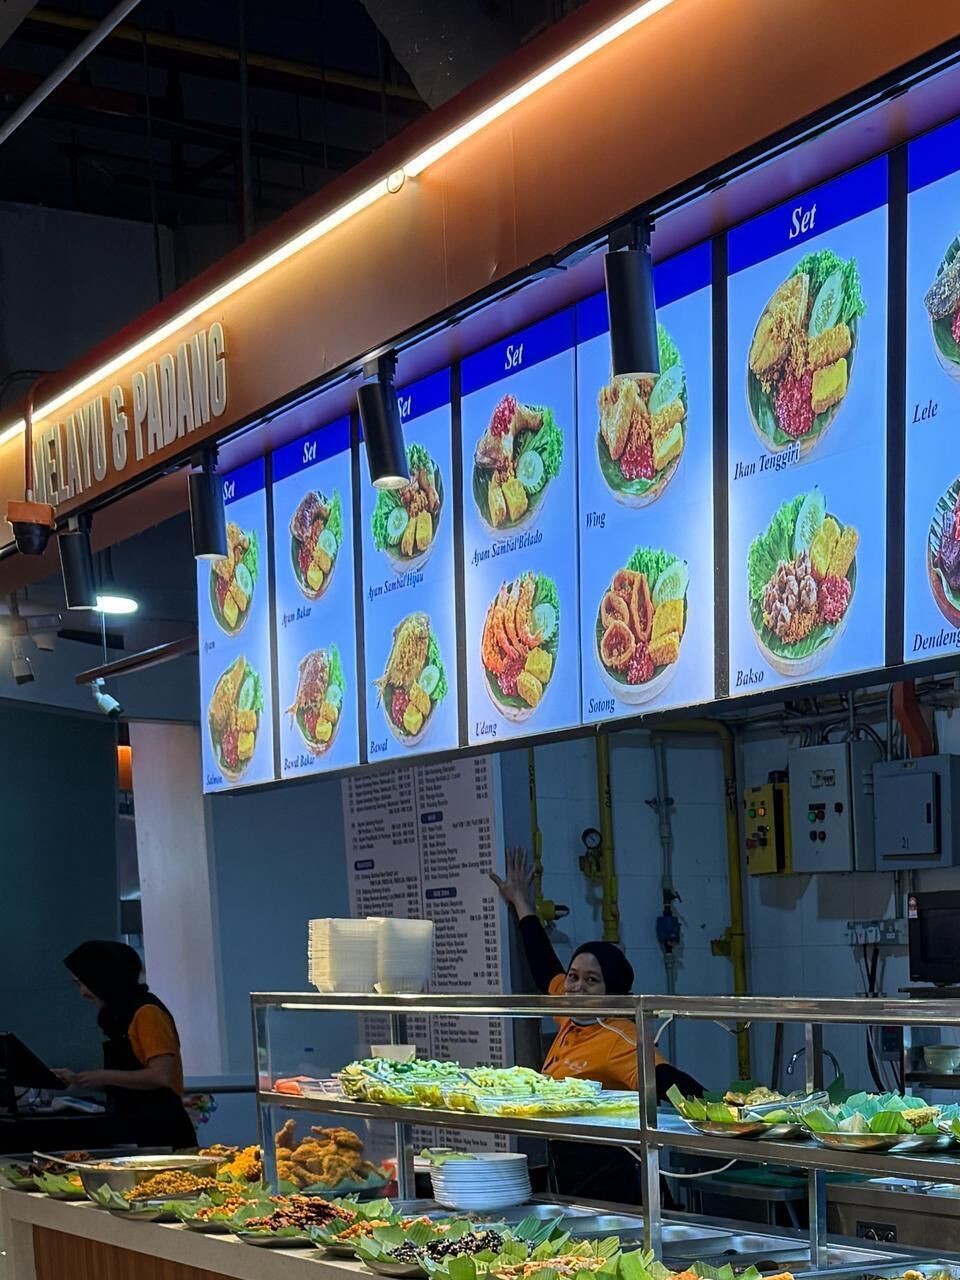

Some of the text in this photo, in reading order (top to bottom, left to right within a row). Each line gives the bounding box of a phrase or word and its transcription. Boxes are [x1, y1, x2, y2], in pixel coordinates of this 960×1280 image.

[788, 202, 818, 240] Set
[504, 343, 524, 370] Set
[31, 321, 227, 504] MELAYU & PADANG
[398, 395, 412, 418] Set
[912, 399, 938, 424] Lele
[302, 441, 317, 464] Set
[734, 443, 800, 480] Ikan Tenggiri
[585, 511, 606, 529] Wing
[491, 538, 517, 558] Sambal
[518, 529, 543, 549] Belado
[735, 670, 765, 687] Bakso
[588, 698, 615, 714] Sotong
